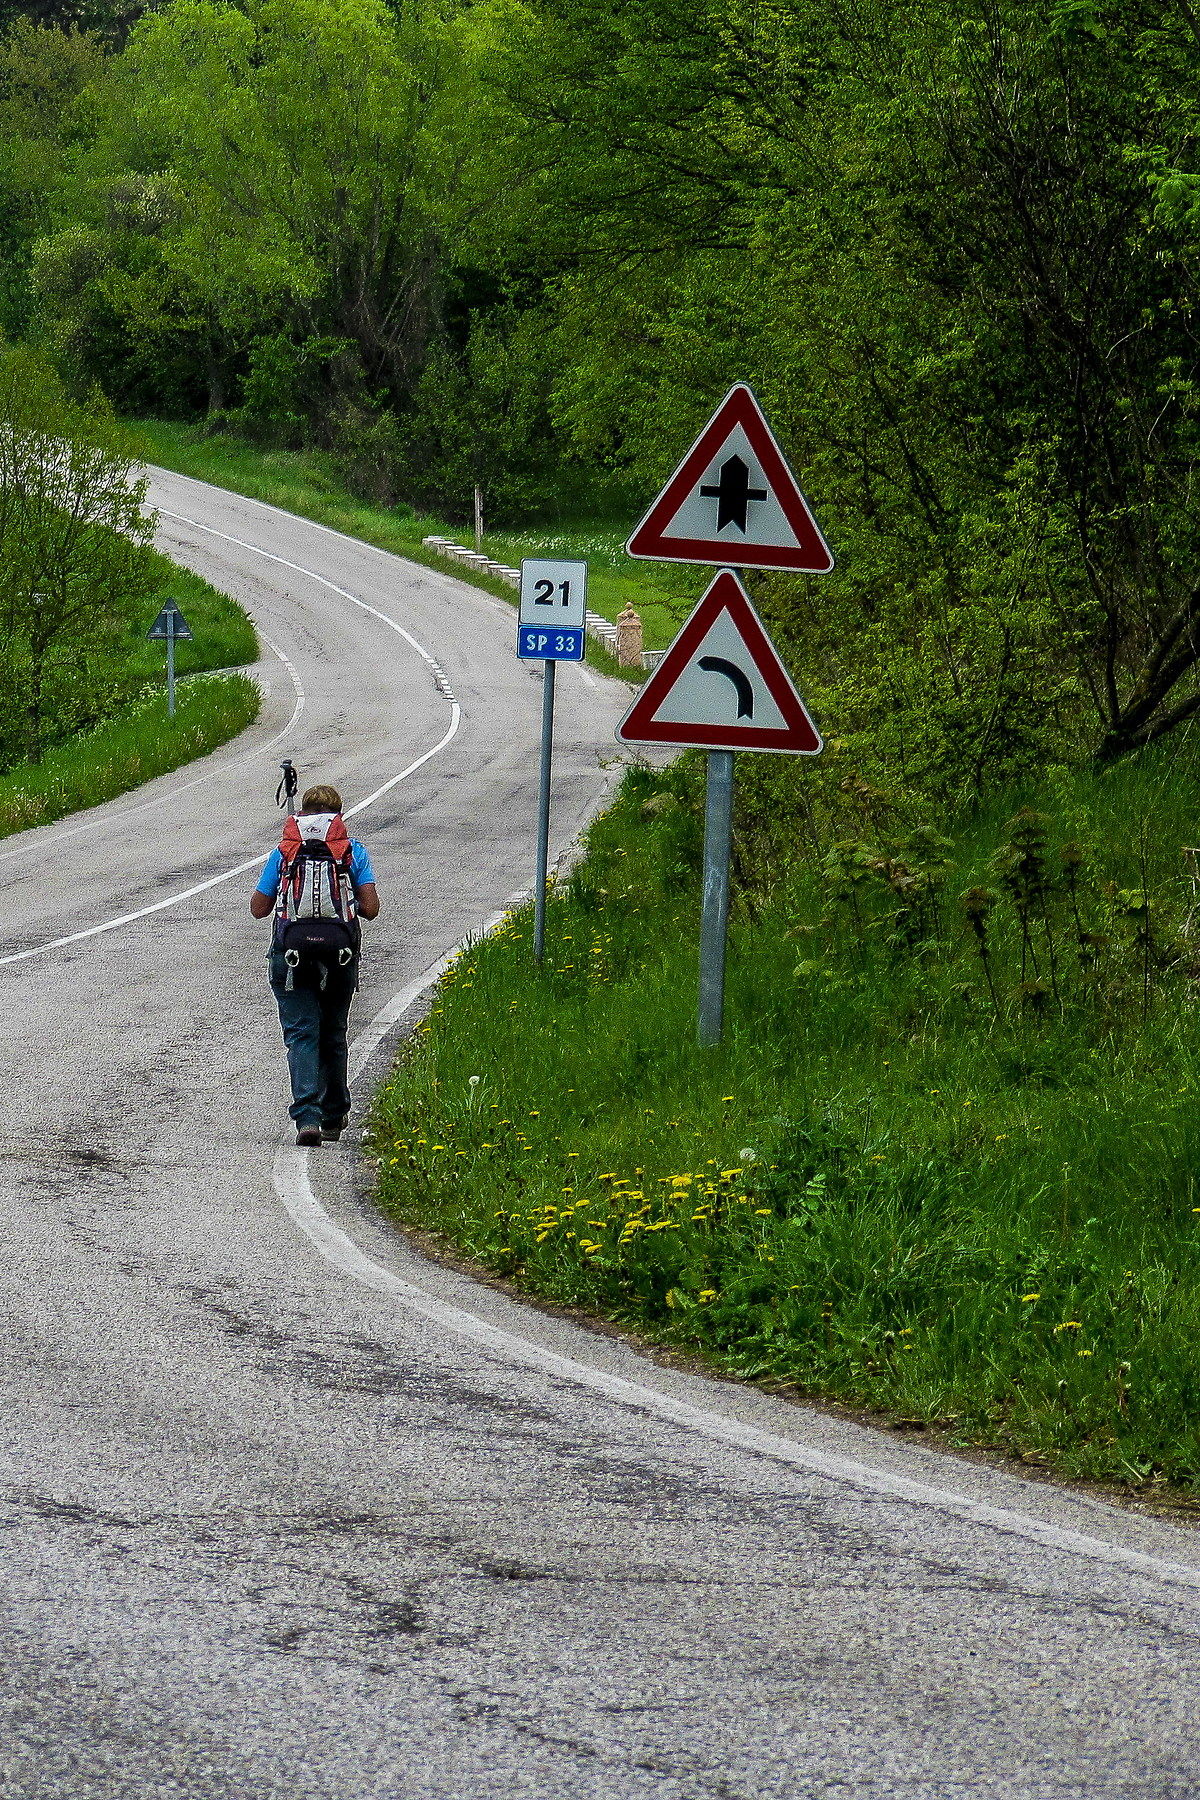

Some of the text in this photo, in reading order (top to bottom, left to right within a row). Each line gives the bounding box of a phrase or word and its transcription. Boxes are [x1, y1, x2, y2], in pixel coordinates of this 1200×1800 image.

[534, 579, 570, 607] 21
[526, 634, 575, 652] SP 33
